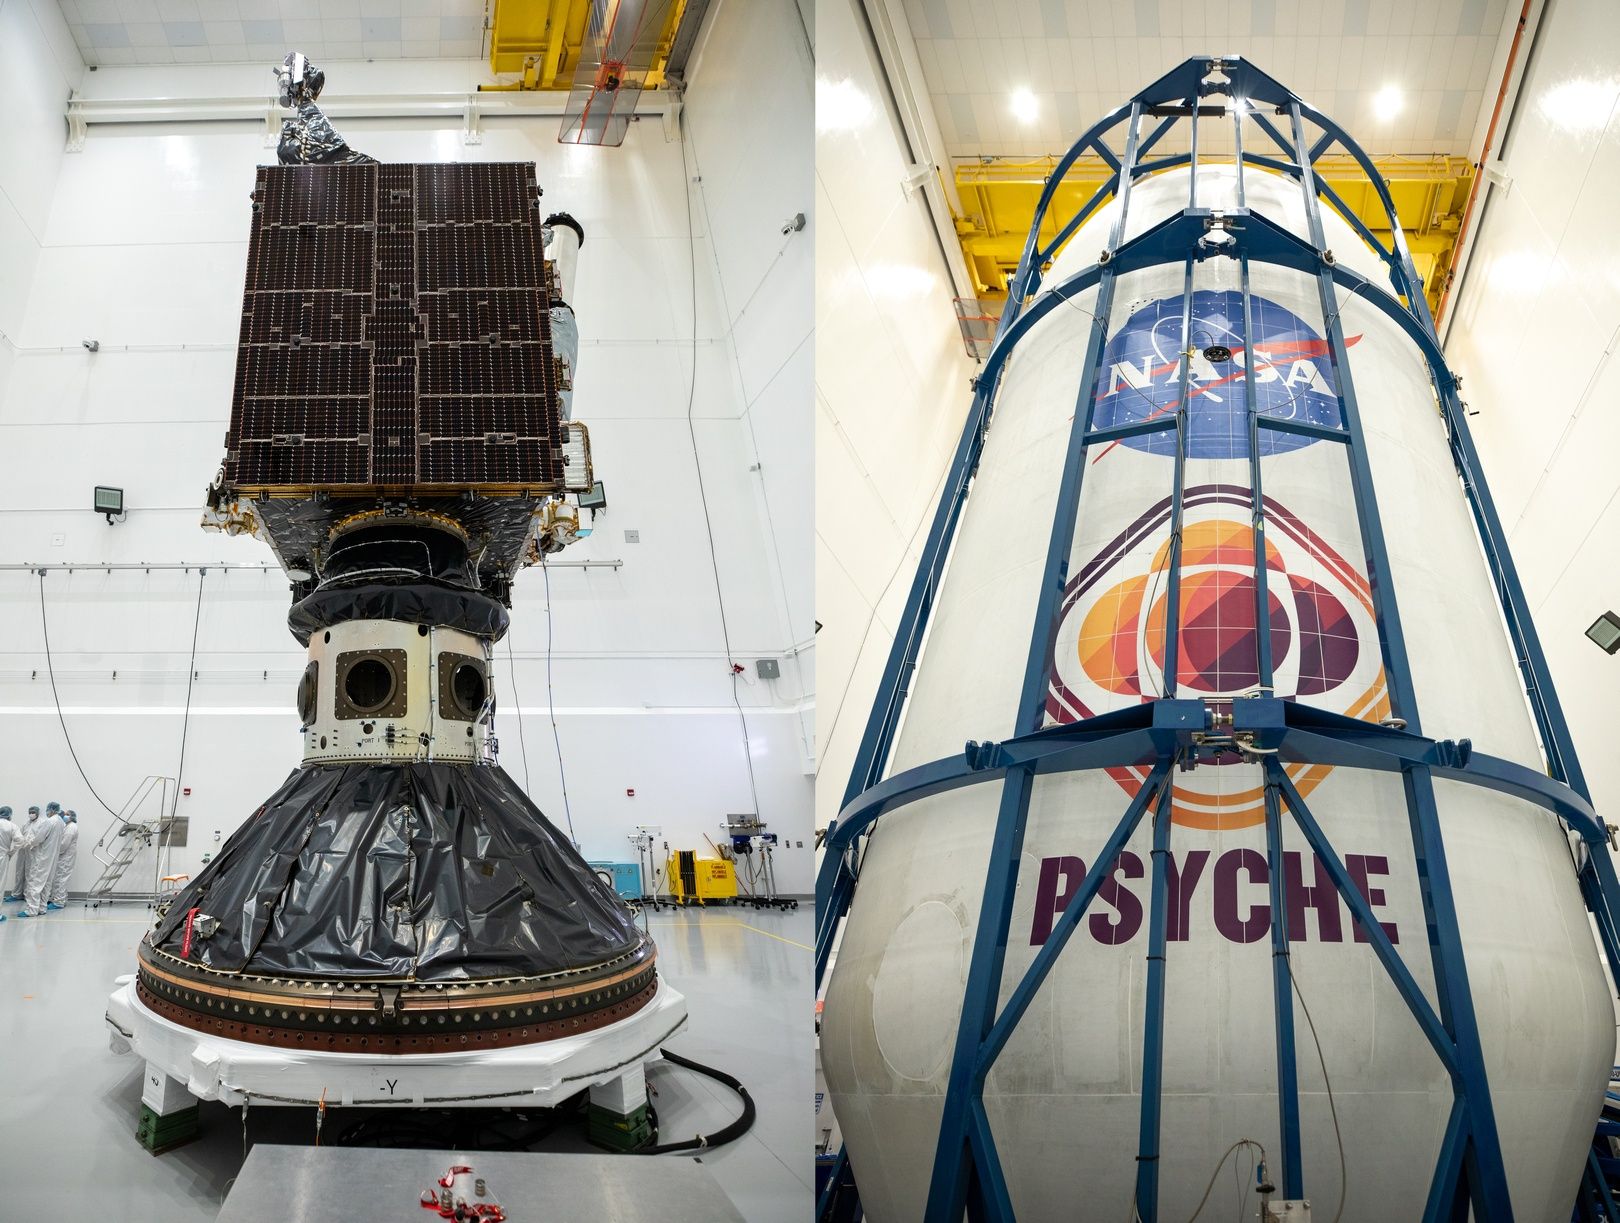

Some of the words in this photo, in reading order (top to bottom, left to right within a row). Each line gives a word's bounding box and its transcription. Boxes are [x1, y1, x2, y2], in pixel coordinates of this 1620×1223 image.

[1104, 349, 1338, 398] NASA
[1029, 848, 1400, 946] PSYCHE
[380, 1079, 398, 1095] -Y
